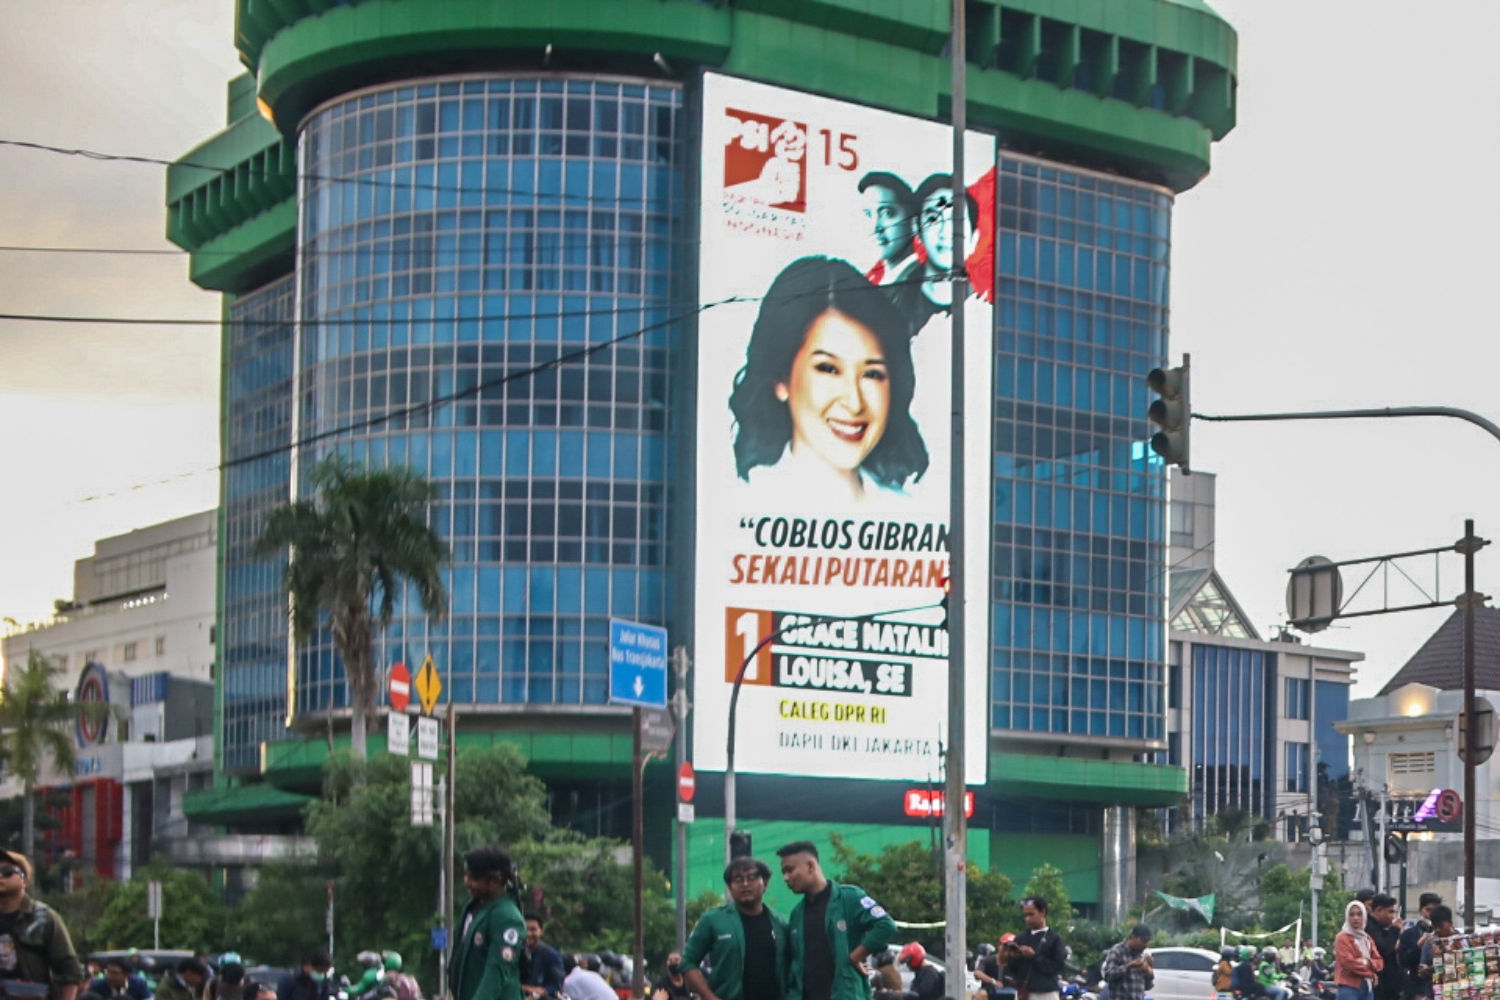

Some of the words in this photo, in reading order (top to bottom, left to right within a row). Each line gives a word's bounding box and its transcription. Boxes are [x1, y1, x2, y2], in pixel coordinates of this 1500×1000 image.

[819, 128, 859, 171] 15
[736, 611, 760, 681] 1
[780, 615, 859, 649] GRACE
[780, 656, 872, 694] LOUISA,
[876, 663, 905, 693] SE
[779, 699, 829, 721] CALEG
[834, 703, 865, 723] DPR
[871, 705, 886, 725] RI
[779, 731, 823, 749] DAPIL
[832, 734, 857, 752] DKI
[865, 736, 932, 756] JAKARTA
